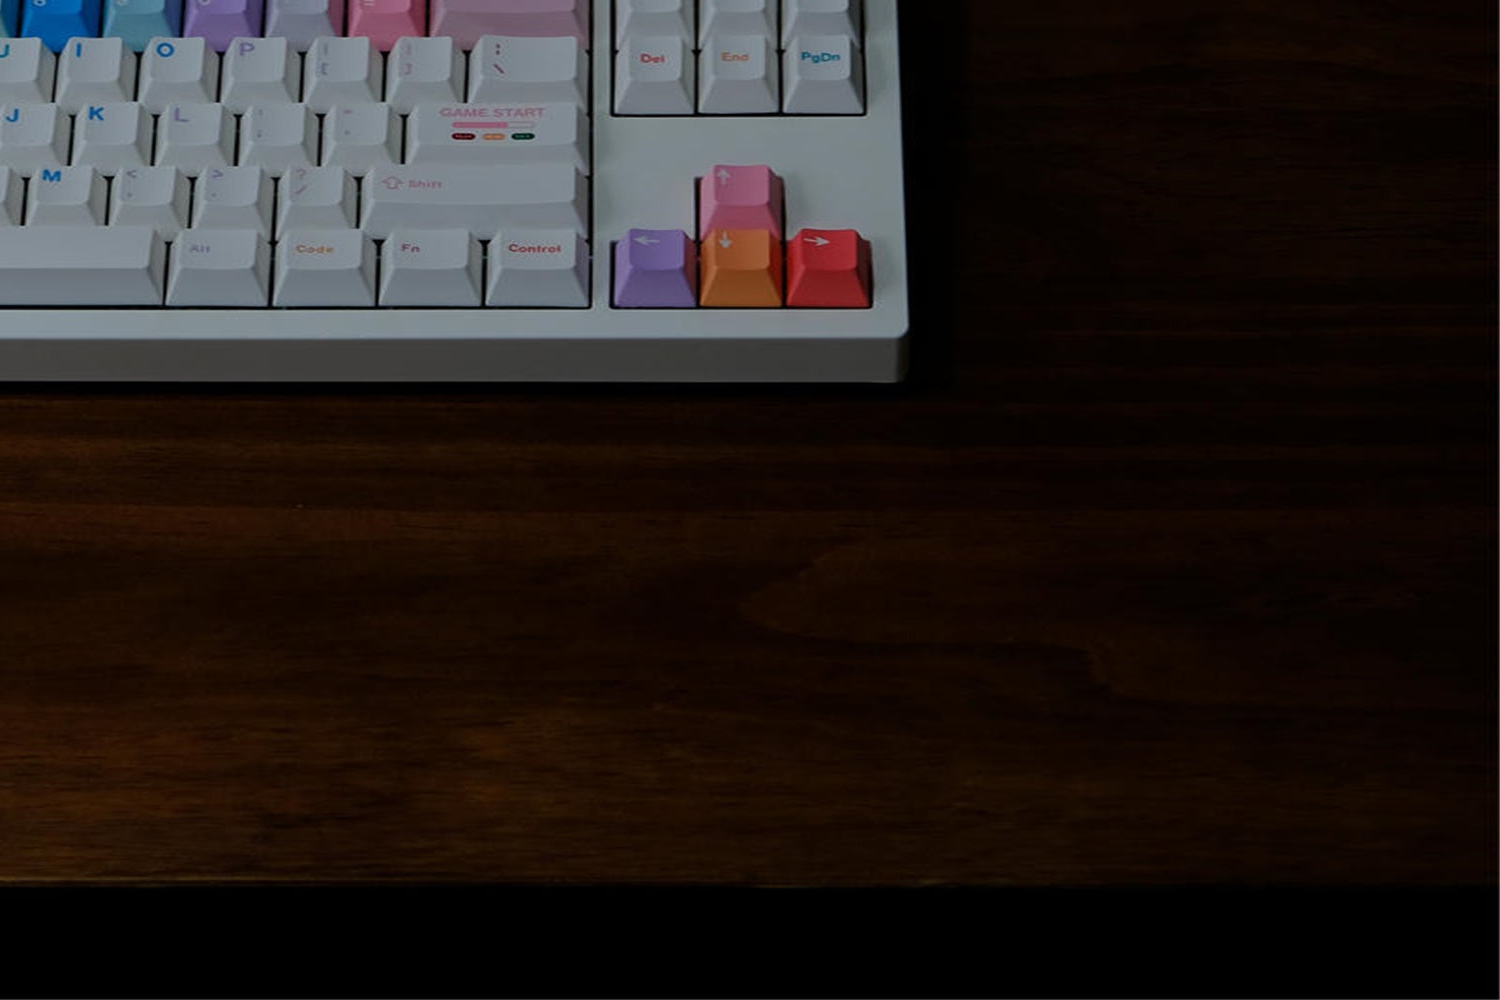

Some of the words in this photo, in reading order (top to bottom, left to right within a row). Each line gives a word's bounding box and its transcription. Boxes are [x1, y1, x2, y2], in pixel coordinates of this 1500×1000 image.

[76, 43, 82, 57] I
[157, 43, 174, 58] O
[240, 42, 254, 56] P
[640, 53, 665, 63] Del
[721, 52, 749, 62] End
[802, 52, 840, 64] PgDn
[7, 109, 20, 122] J
[89, 107, 104, 121] K
[175, 108, 189, 122] L
[441, 108, 486, 117] GAME
[494, 108, 545, 117] START
[43, 170, 61, 182] M
[408, 179, 443, 189] Shift
[296, 245, 334, 254] Code
[402, 244, 420, 253] Fn
[509, 244, 561, 253] Control
